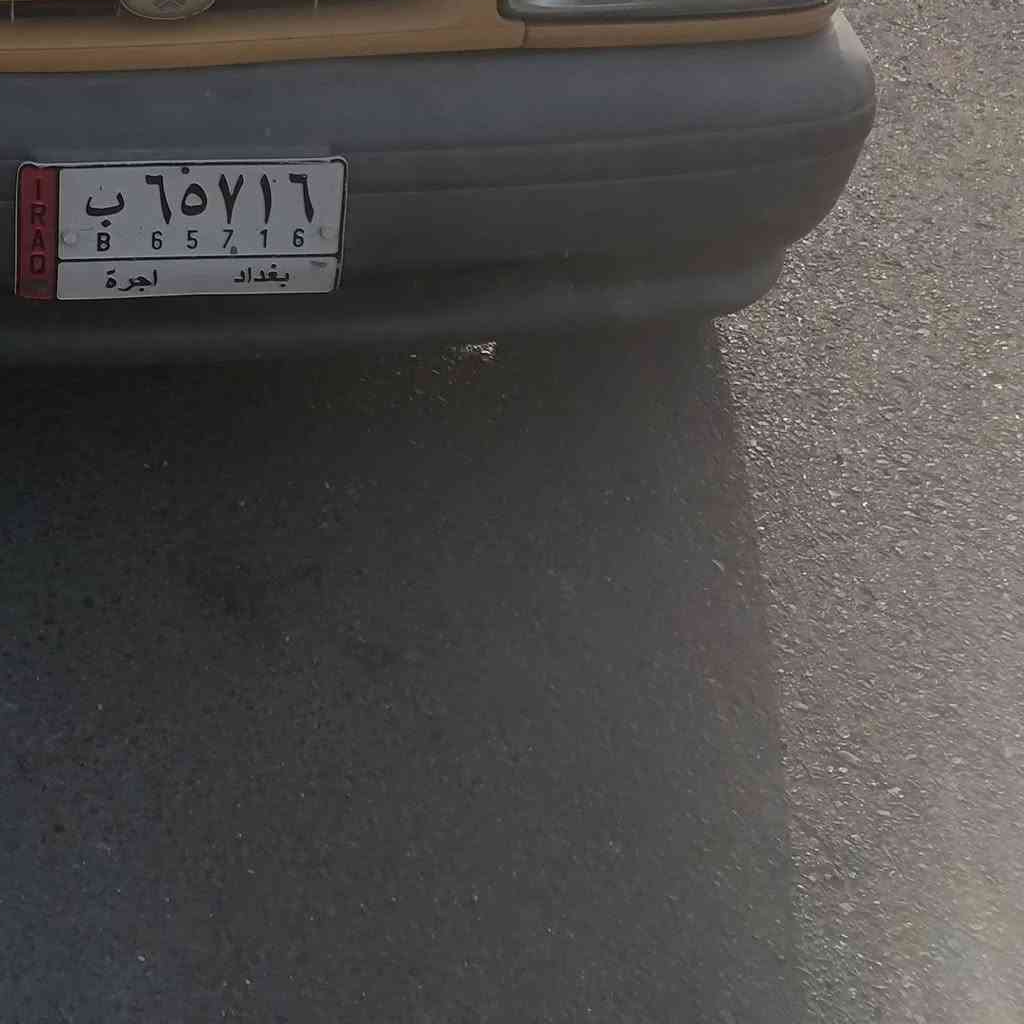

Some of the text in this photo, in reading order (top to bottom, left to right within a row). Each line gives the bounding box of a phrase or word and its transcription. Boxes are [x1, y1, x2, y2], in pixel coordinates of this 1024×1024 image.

[145, 173, 315, 225] ٦٥٧١٦
[96, 231, 111, 252] B
[104, 263, 290, 292] بغداد اجرة
